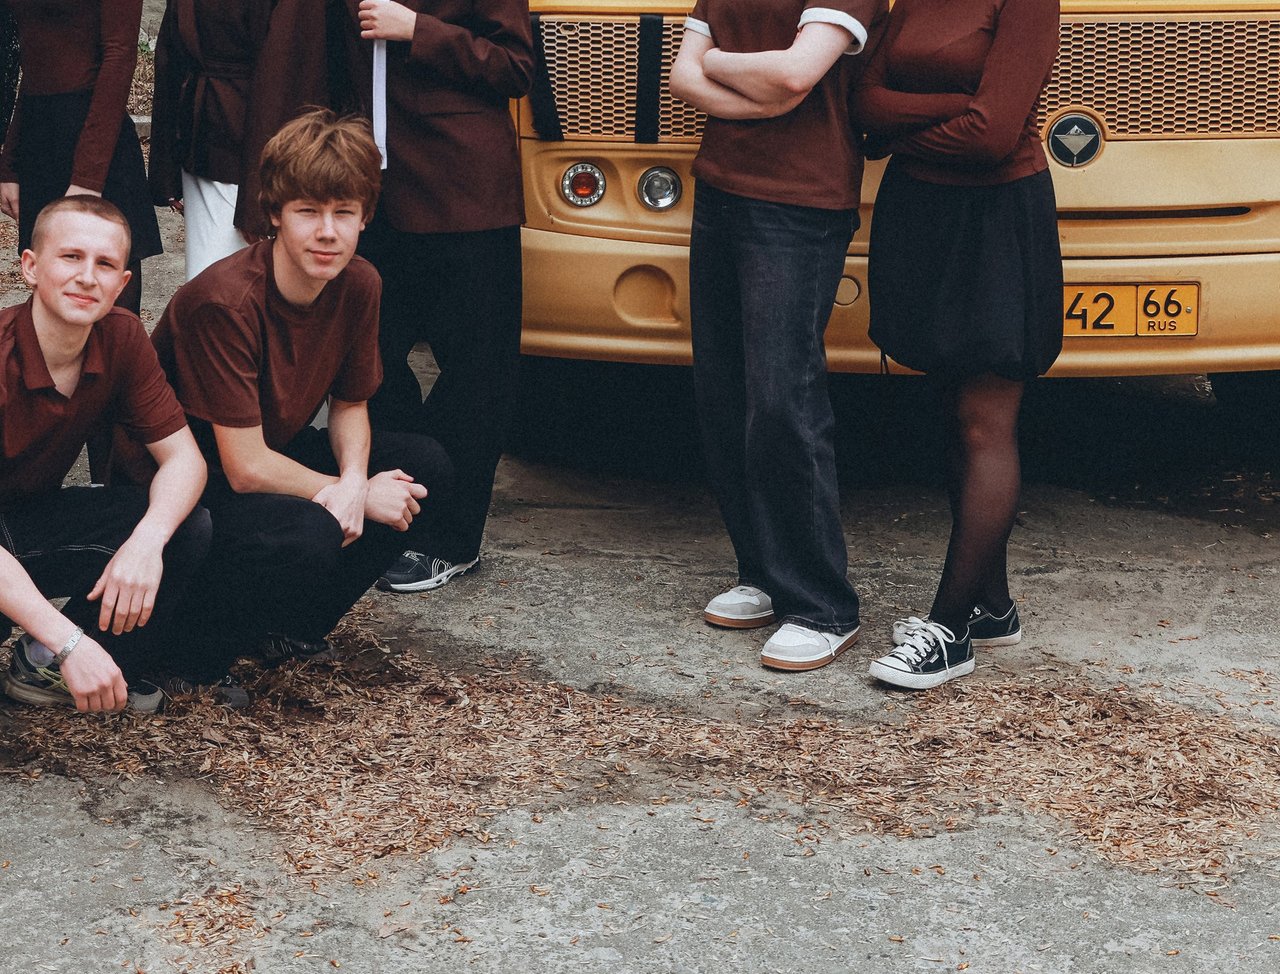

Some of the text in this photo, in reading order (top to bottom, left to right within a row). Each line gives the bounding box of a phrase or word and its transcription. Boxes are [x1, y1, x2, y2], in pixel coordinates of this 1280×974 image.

[1065, 289, 1182, 330] 42 66
[1147, 320, 1177, 331] RUS
